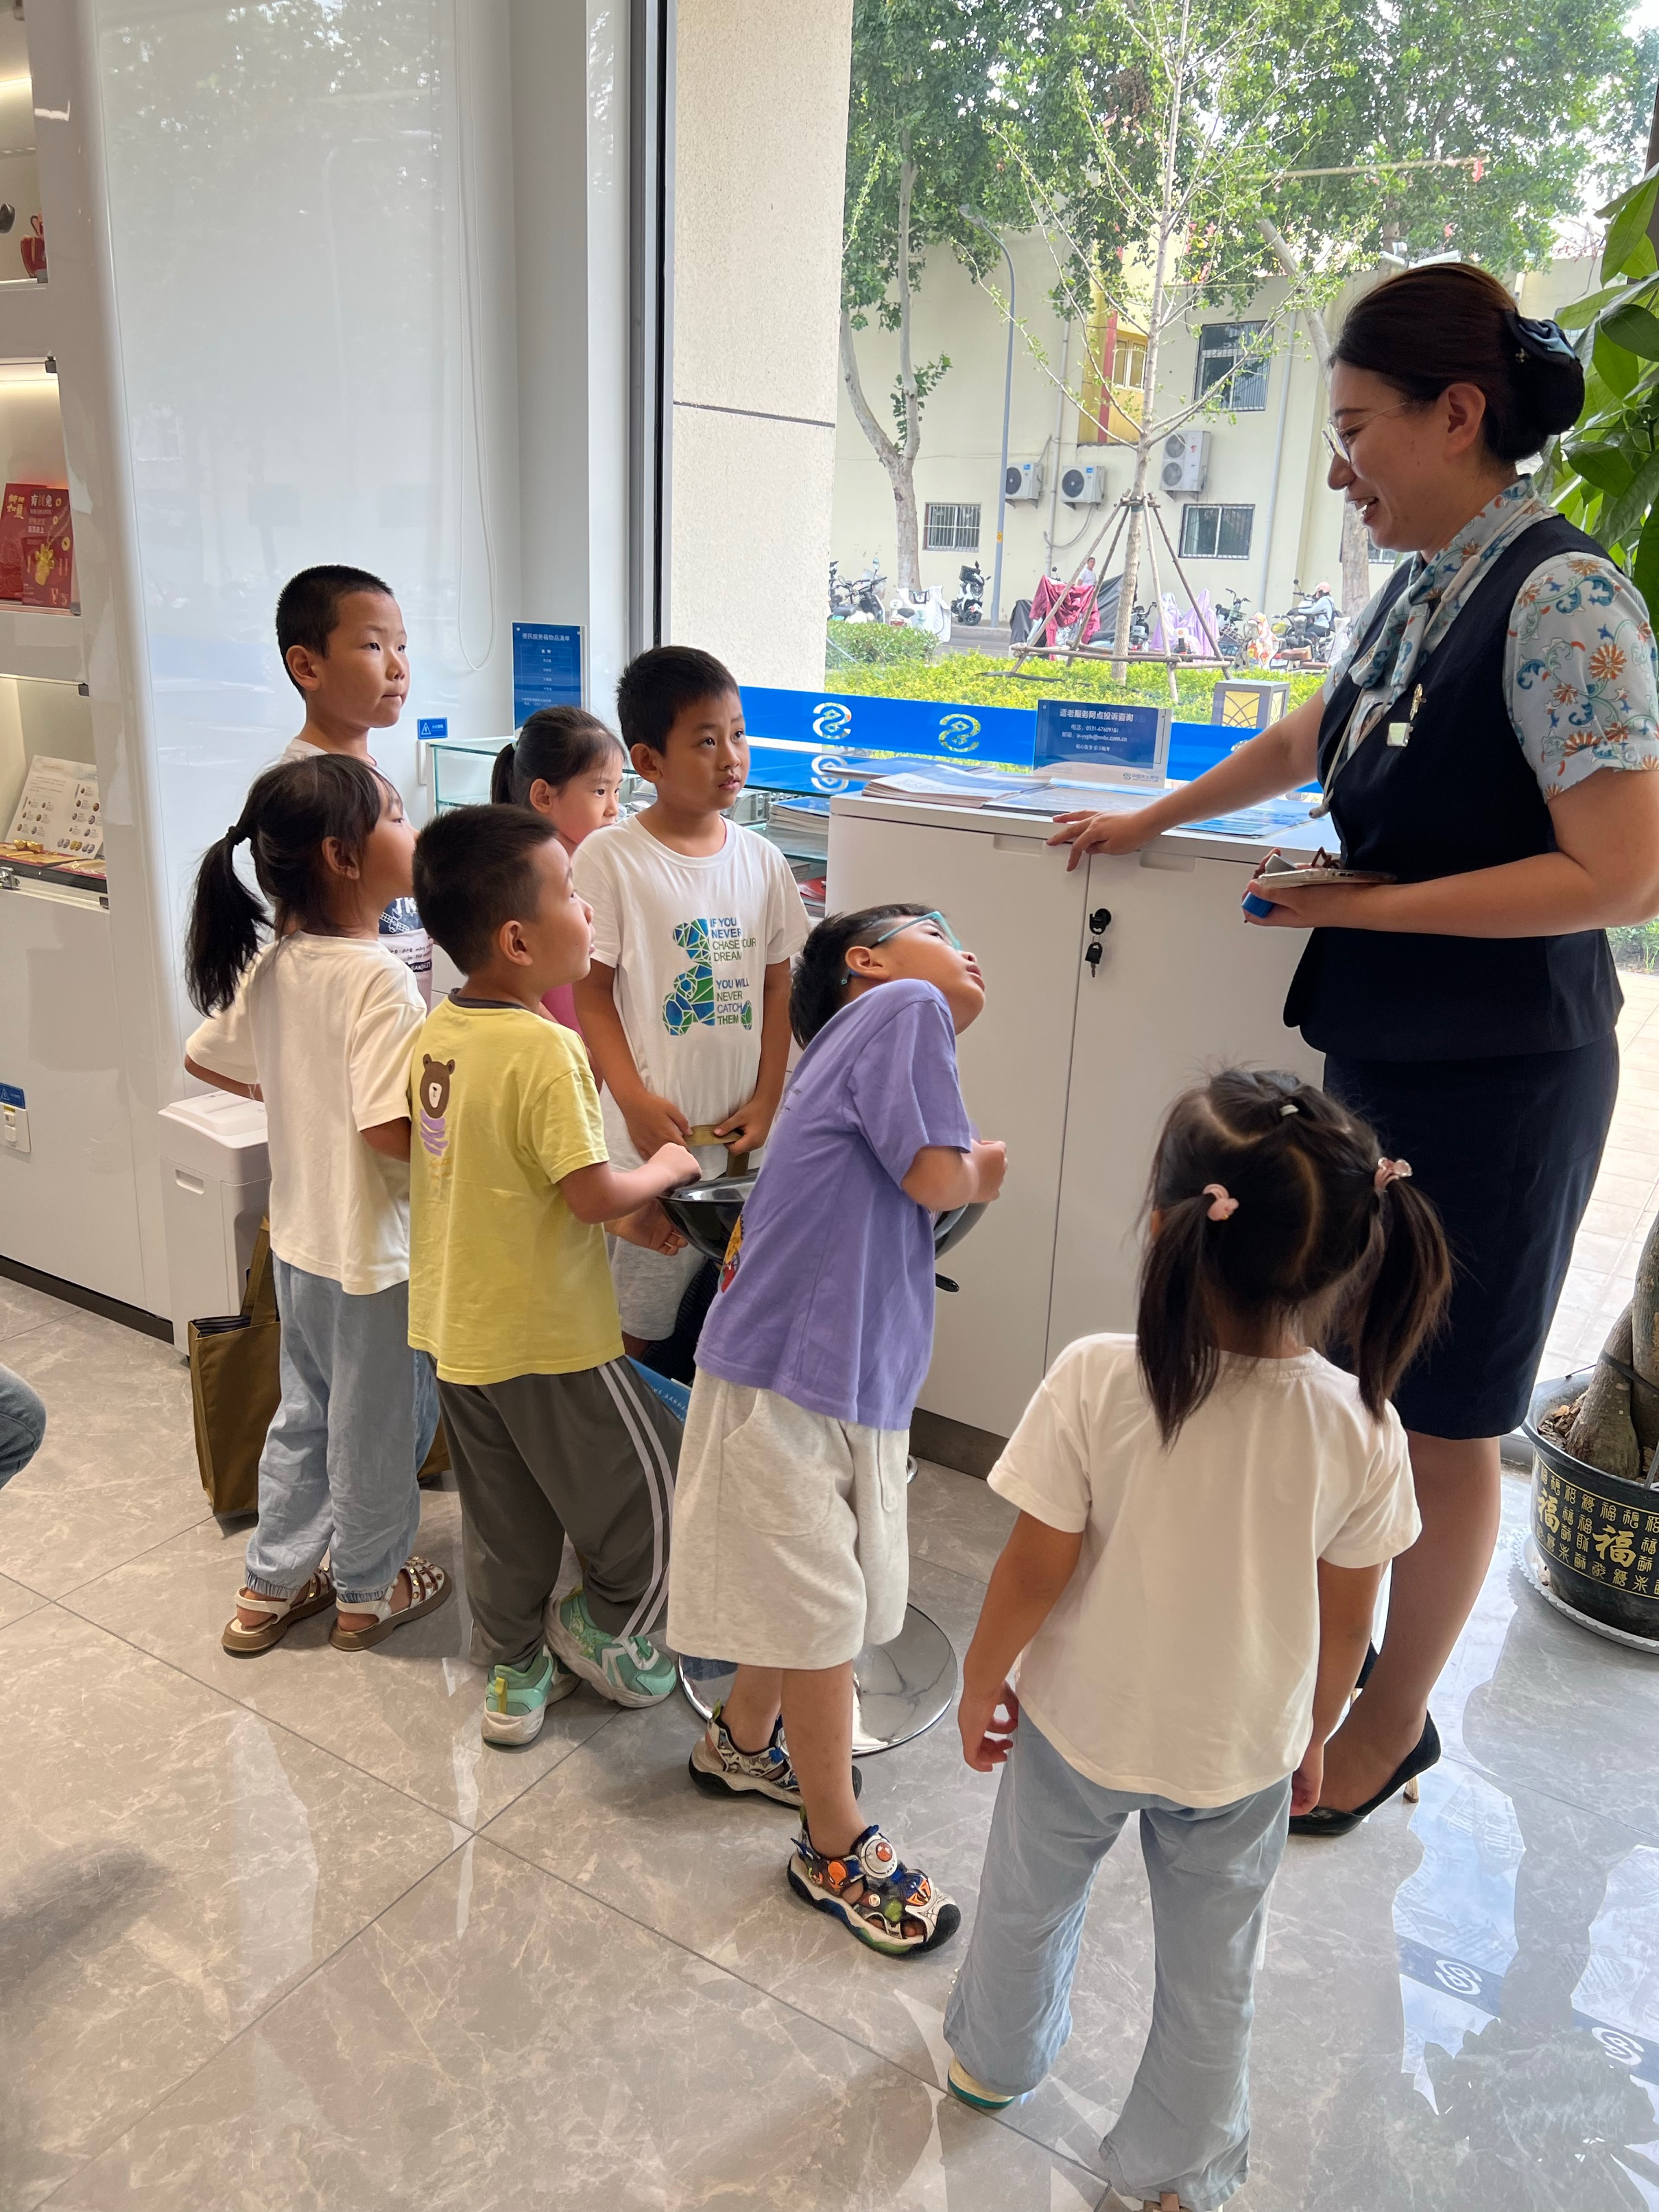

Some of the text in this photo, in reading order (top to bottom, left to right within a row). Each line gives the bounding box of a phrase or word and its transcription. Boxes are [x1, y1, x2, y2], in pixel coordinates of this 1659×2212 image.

[1060, 709, 1134, 722] 适老服务网点投诉咨询
[710, 917, 737, 927] IF YOU
[713, 940, 740, 950] CHASE
[716, 979, 733, 989] YOU
[717, 991, 743, 1001] NEVER
[717, 1002, 743, 1014] CATCH
[717, 1014, 739, 1025] THEM
[1538, 1488, 1560, 1534] 福
[1592, 1524, 1636, 1567] 福
